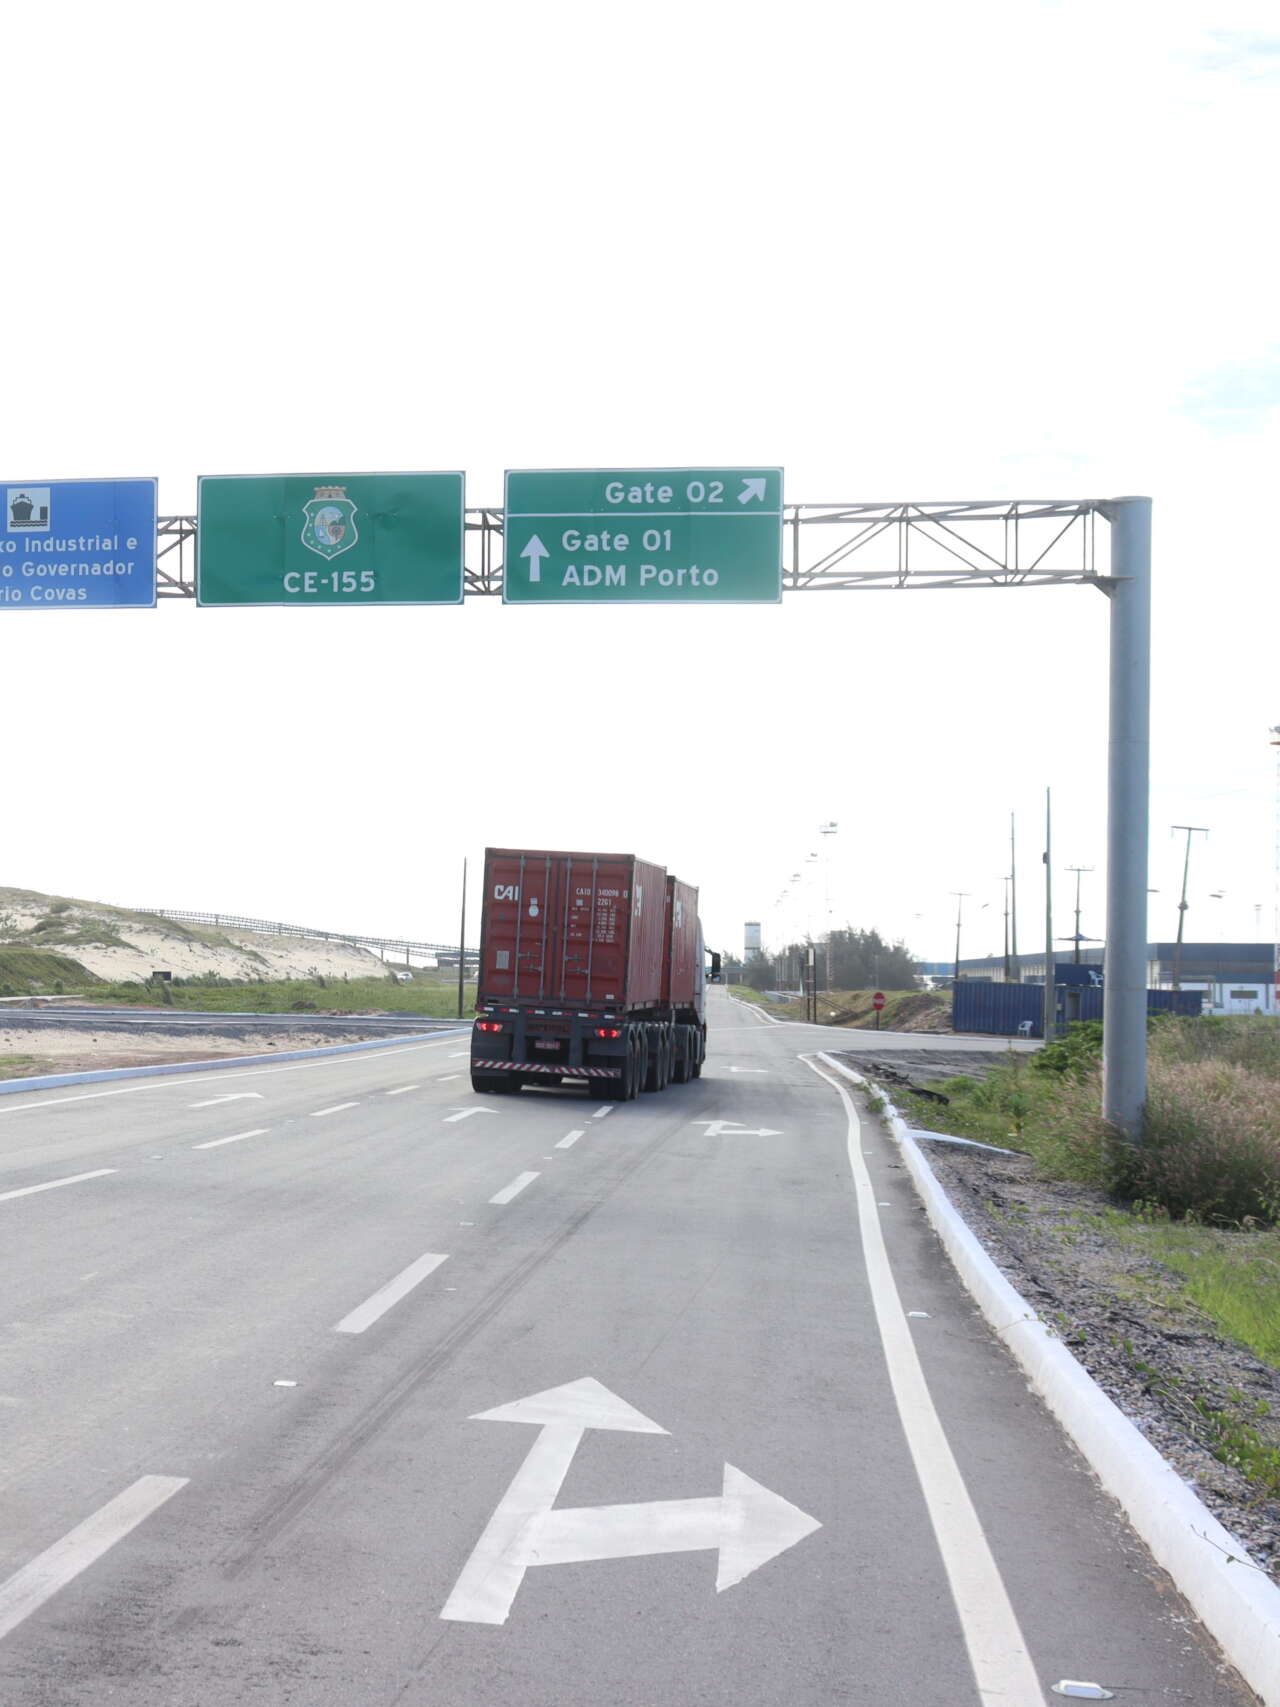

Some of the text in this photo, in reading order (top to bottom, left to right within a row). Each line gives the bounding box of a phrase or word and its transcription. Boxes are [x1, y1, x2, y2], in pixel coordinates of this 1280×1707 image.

[606, 481, 725, 504] Gate 02
[24, 535, 118, 553] Industrial
[126, 537, 138, 550] e
[562, 529, 672, 552] Gate 01
[22, 560, 135, 577] Governador
[562, 564, 720, 587] ADM Porto
[283, 571, 375, 593] CE-155
[30, 586, 88, 602] Covas
[494, 885, 518, 901] CAI
